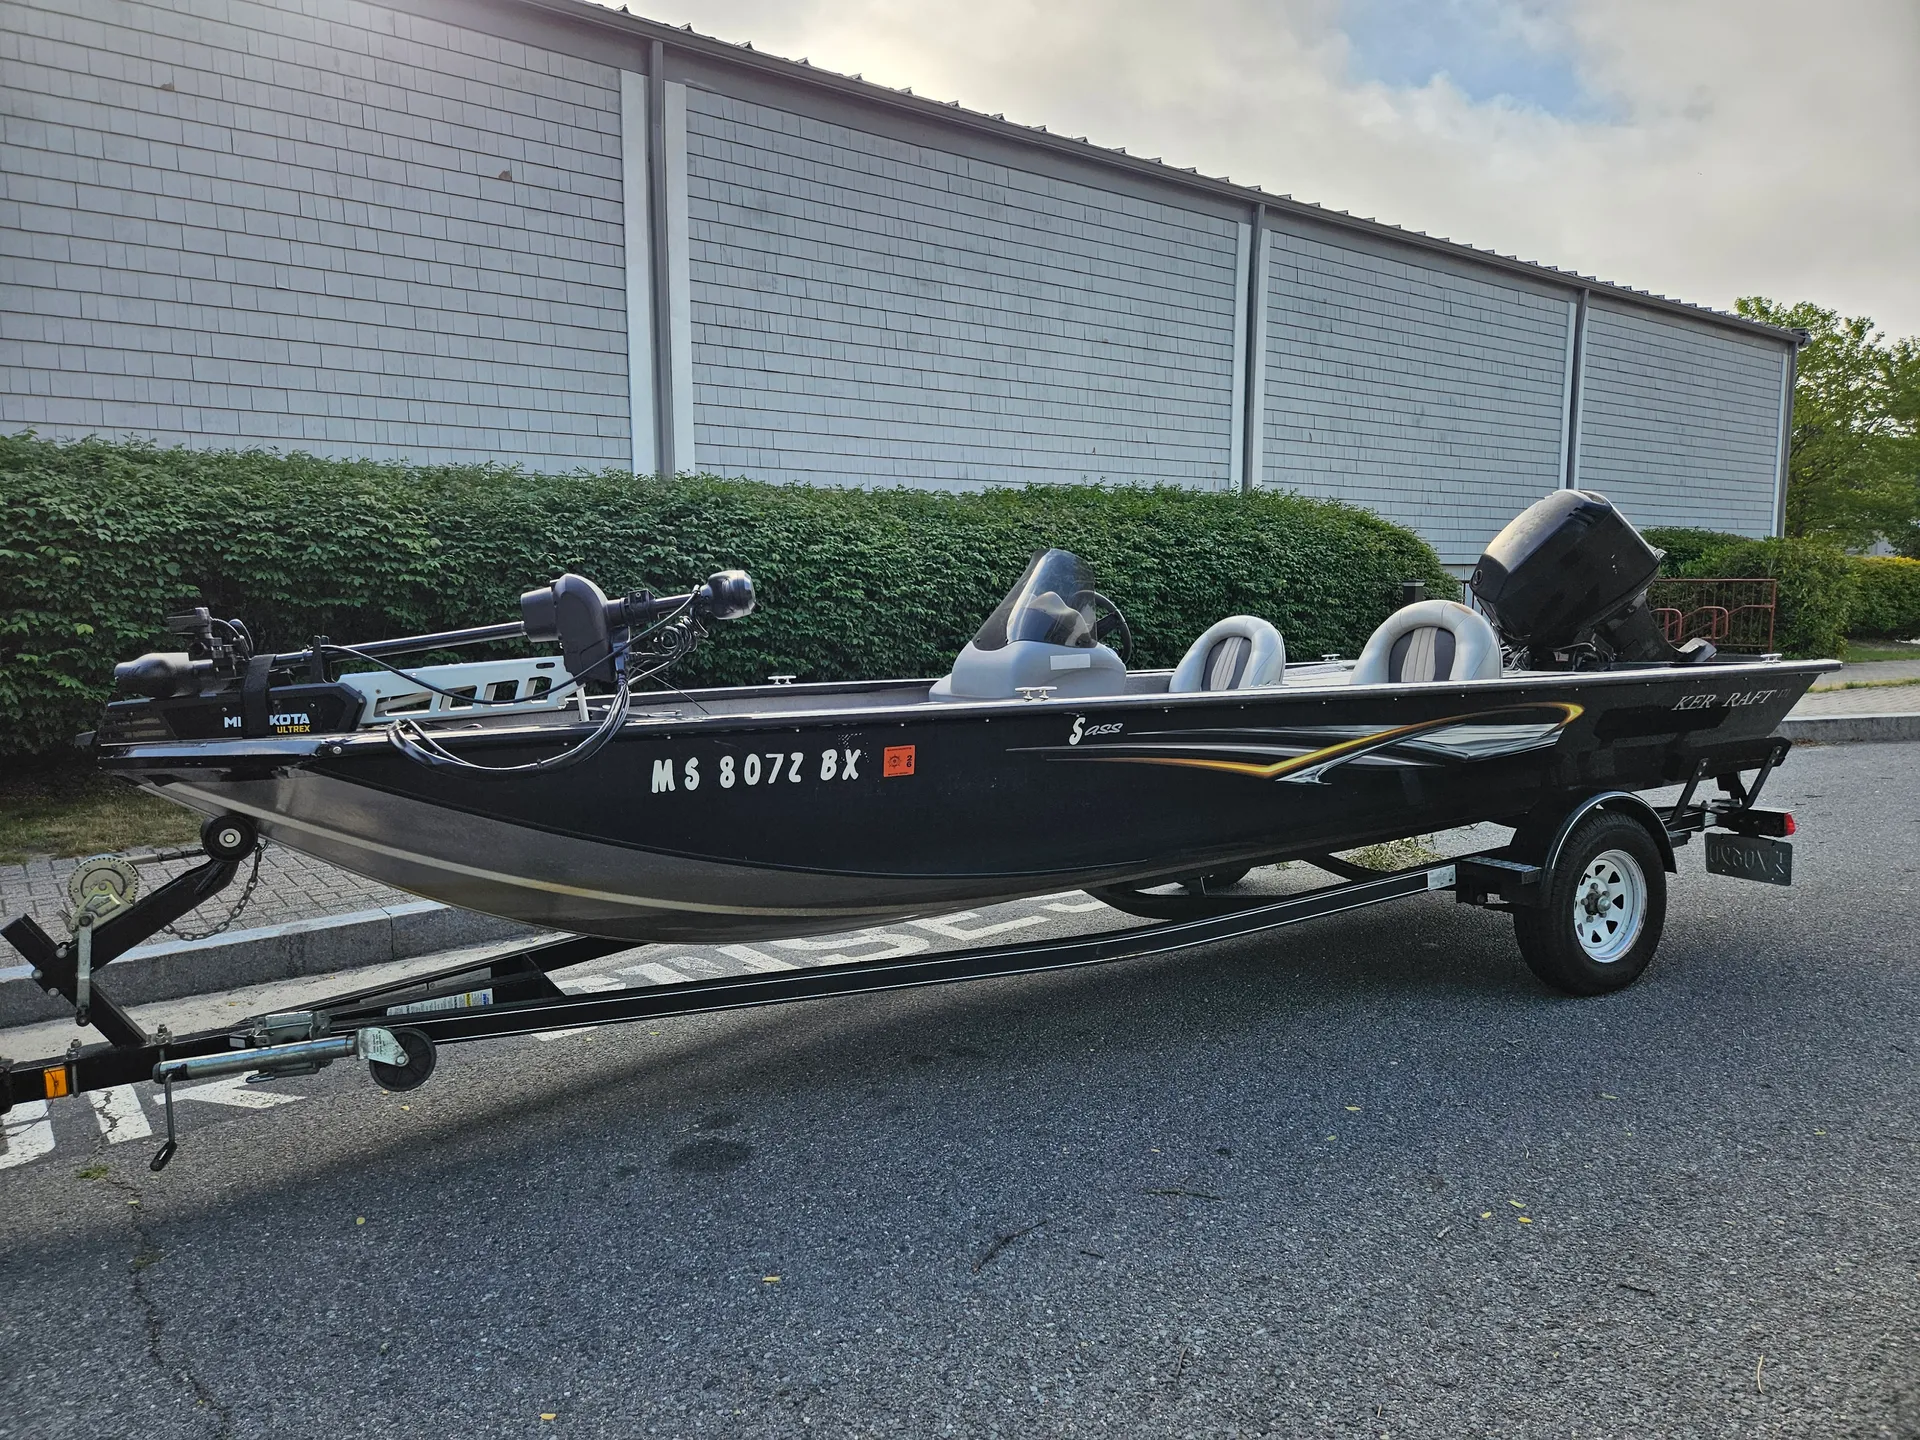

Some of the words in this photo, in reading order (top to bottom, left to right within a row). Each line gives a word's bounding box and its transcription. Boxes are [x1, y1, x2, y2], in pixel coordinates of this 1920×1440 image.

[1721, 688, 1777, 708] RAFT
[223, 716, 242, 729] MI
[269, 713, 311, 727] KOTA
[276, 724, 311, 734] ULTREX
[651, 757, 700, 794] MS
[720, 751, 804, 789] 8072
[820, 749, 862, 781] BX
